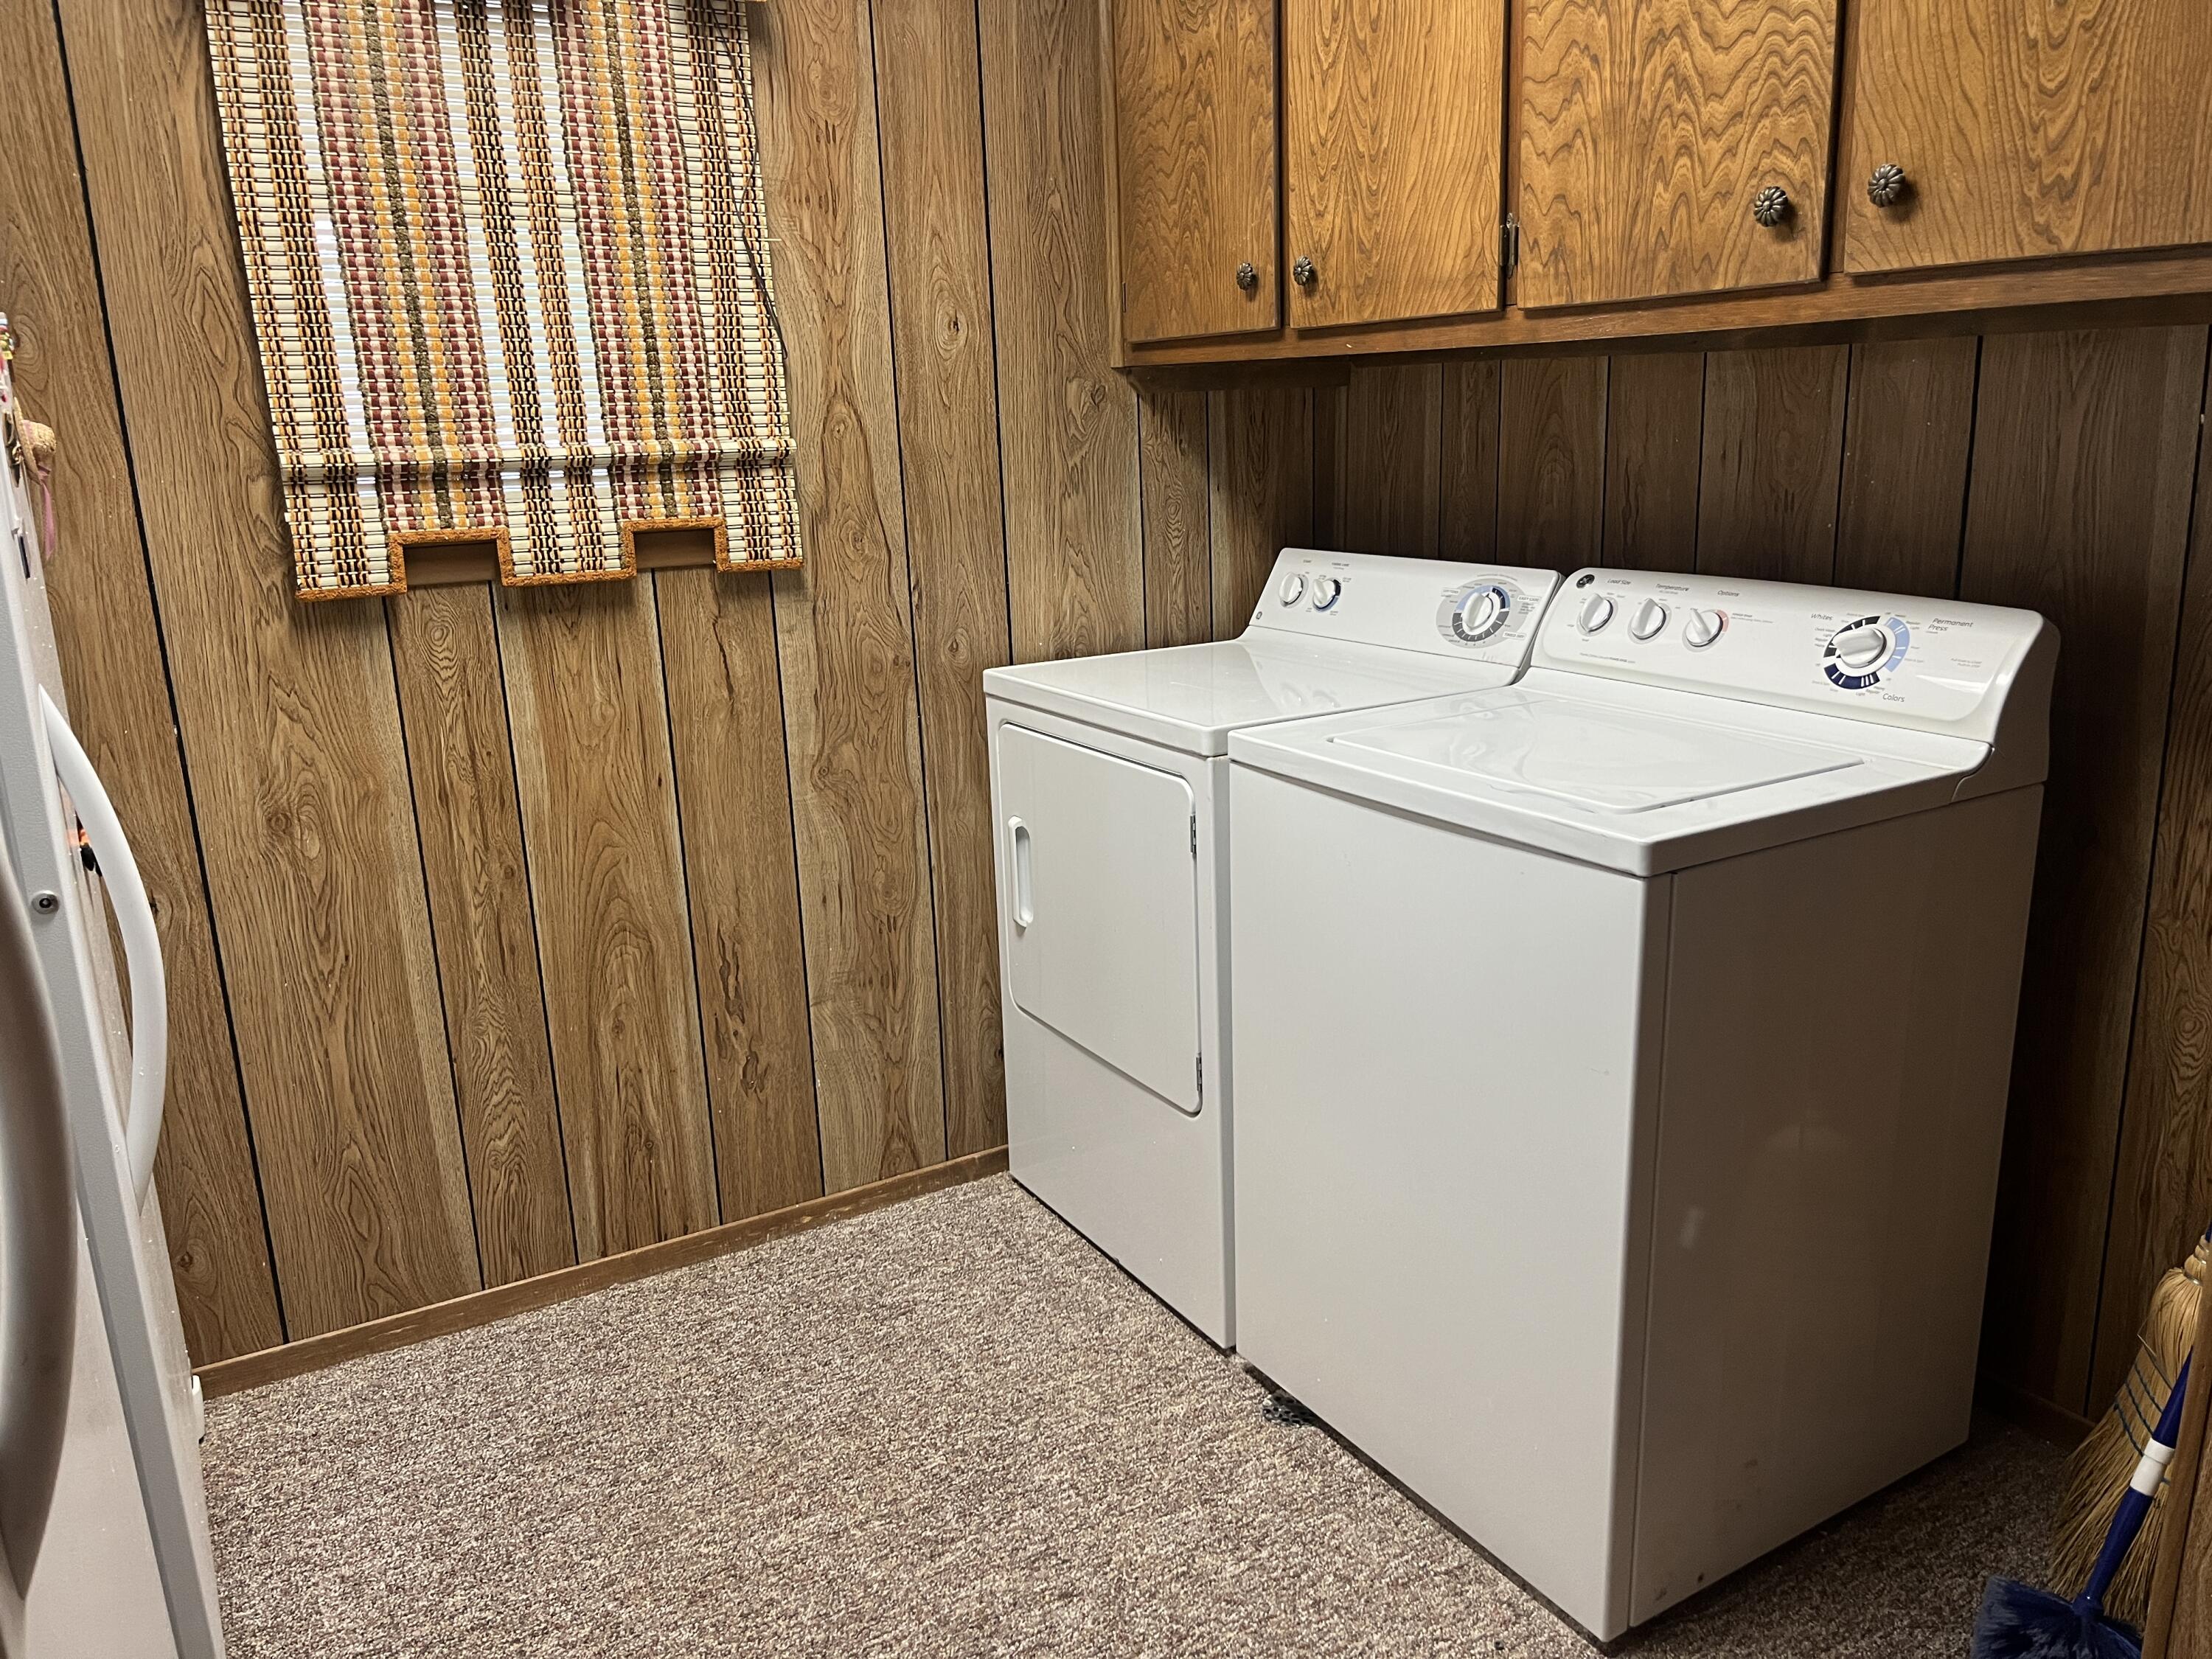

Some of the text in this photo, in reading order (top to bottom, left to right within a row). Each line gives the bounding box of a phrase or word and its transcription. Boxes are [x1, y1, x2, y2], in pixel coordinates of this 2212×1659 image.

[1655, 583, 1689, 592] Temperature
[1717, 589, 1740, 597] Options
[1932, 618, 1974, 627] Permanent
[1927, 624, 1949, 632] Press
[1882, 692, 1905, 703] Colors
